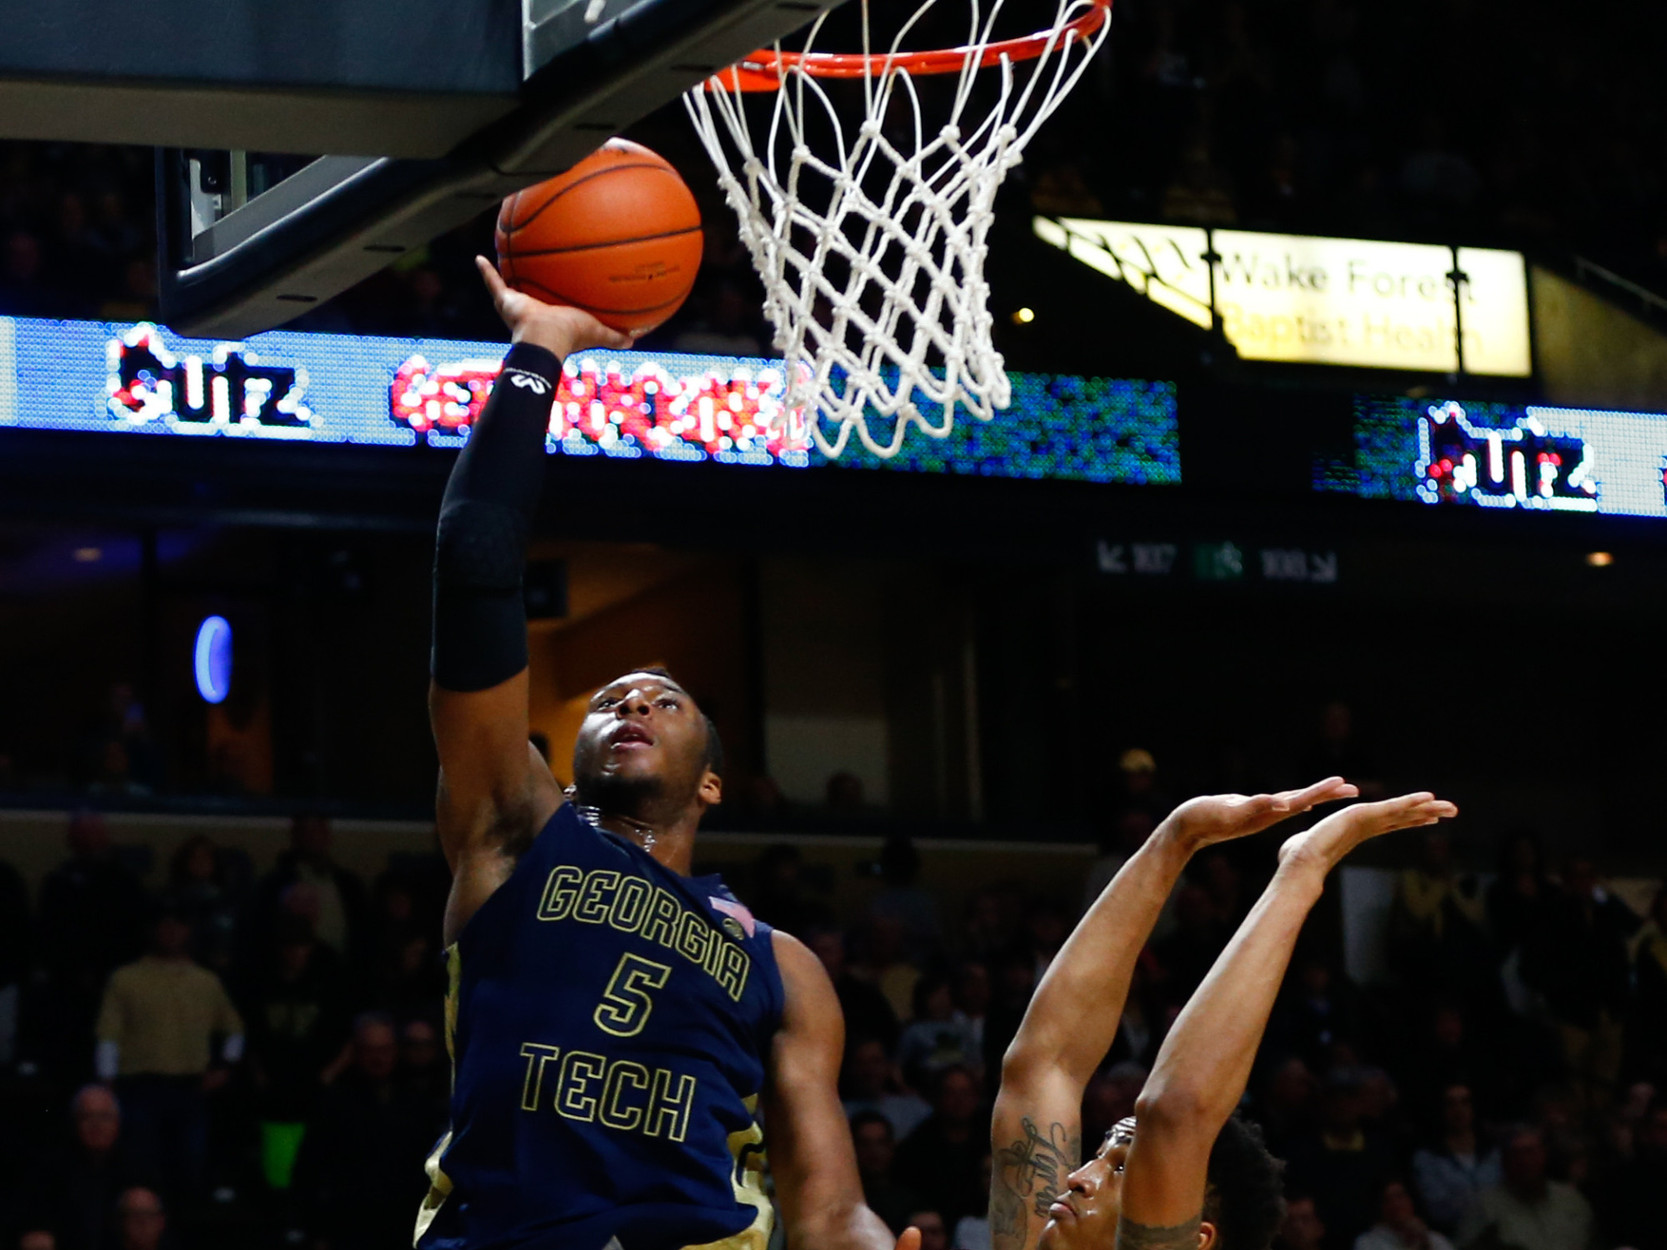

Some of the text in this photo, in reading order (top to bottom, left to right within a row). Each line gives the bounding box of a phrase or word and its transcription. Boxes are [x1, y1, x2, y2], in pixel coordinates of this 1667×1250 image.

[1213, 249, 1327, 291] Wake
[1361, 313, 1485, 354] Healh
[537, 865, 750, 1002] GEORGIA
[593, 952, 672, 1037] 5
[520, 1042, 696, 1142] TECH
